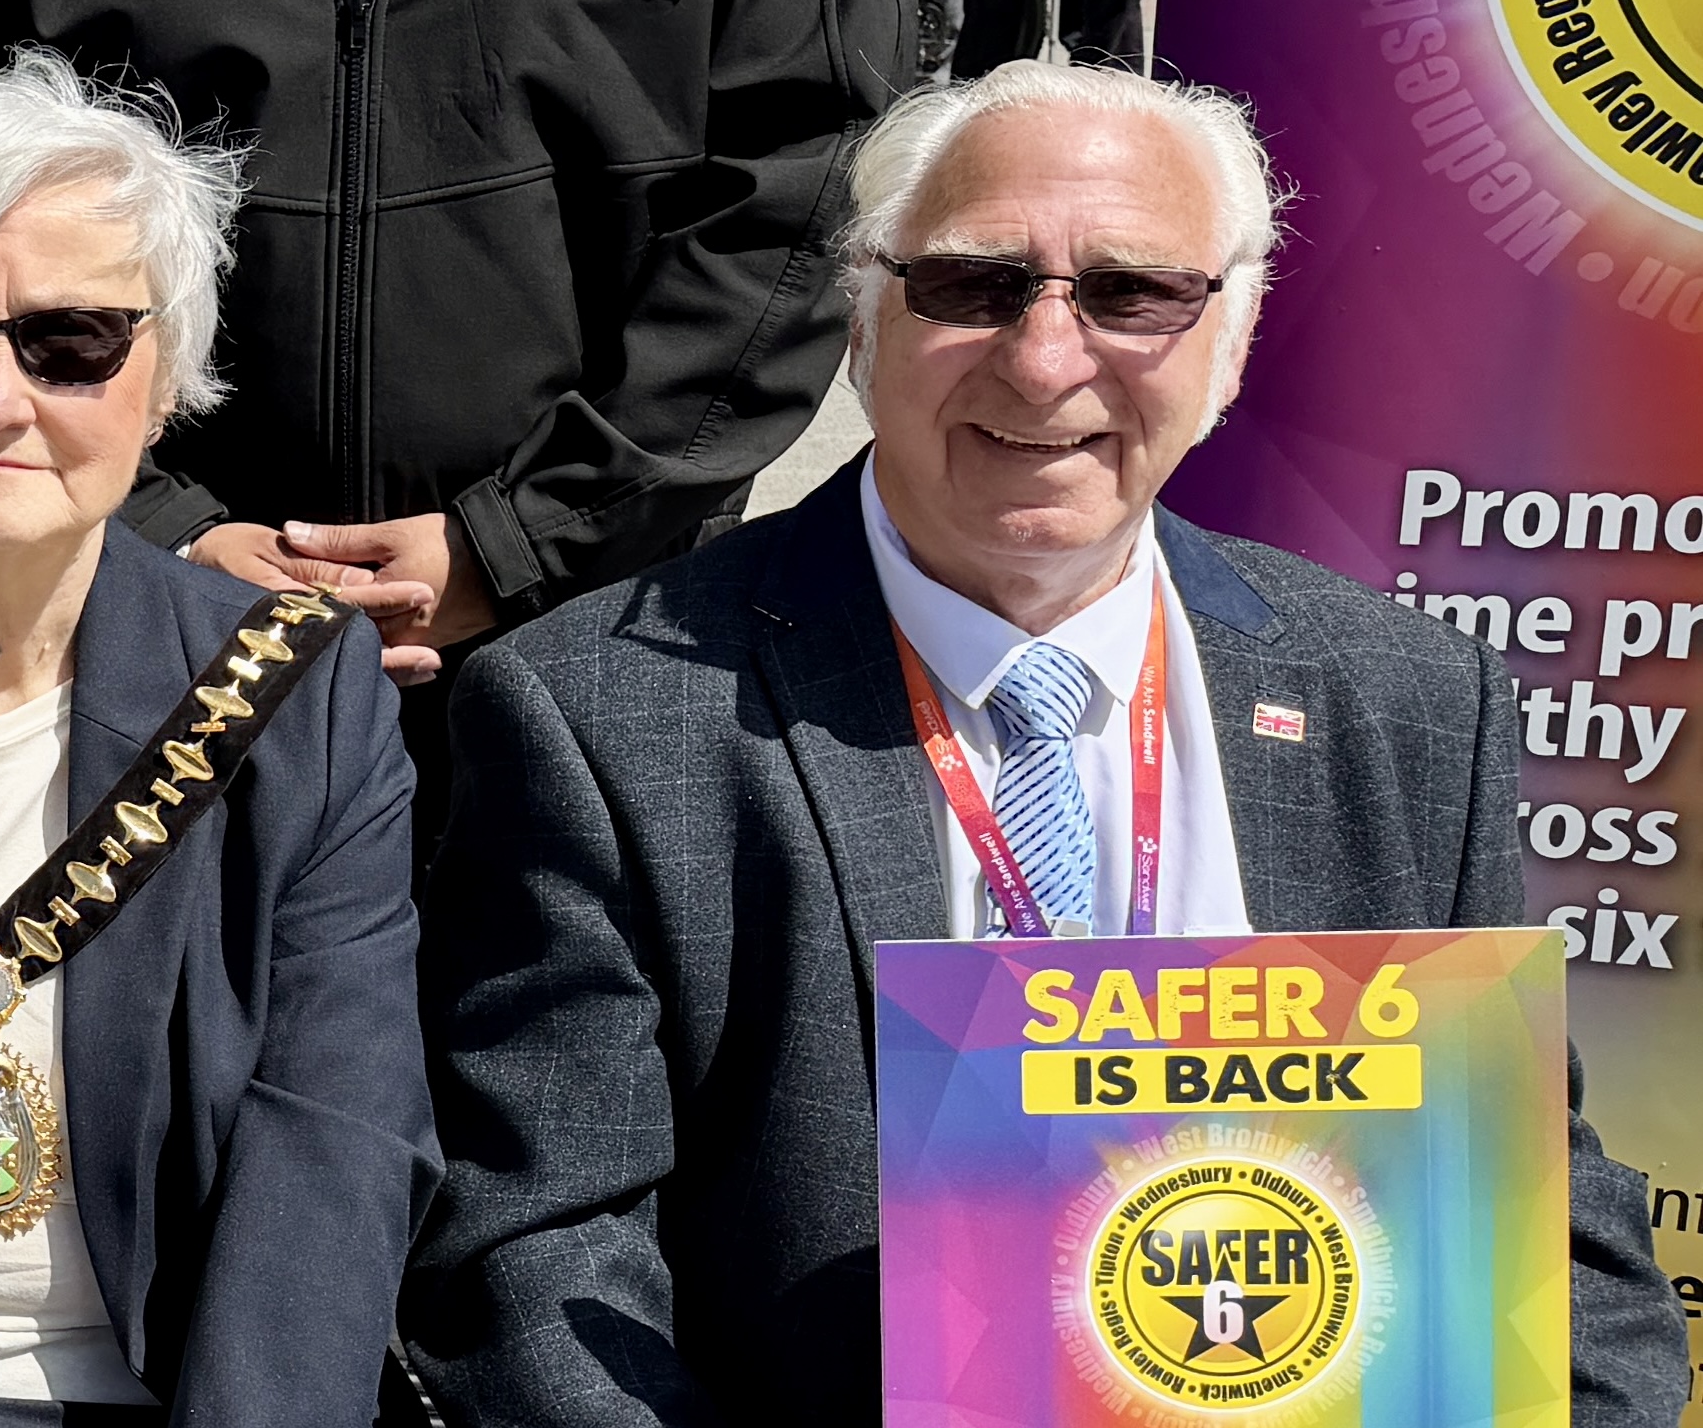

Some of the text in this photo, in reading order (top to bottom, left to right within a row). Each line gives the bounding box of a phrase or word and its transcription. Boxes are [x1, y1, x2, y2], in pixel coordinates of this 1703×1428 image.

[1399, 467, 1703, 554] Promo
[1142, 708, 1156, 766] Sandwell
[978, 831, 1016, 891] Sandwell
[1546, 886, 1680, 970] six
[1022, 963, 1420, 1044] SAFER 6
[1074, 1052, 1369, 1106] IS BACK
[1139, 1229, 1310, 1287] SAFER
[1202, 1279, 1245, 1345] 6
